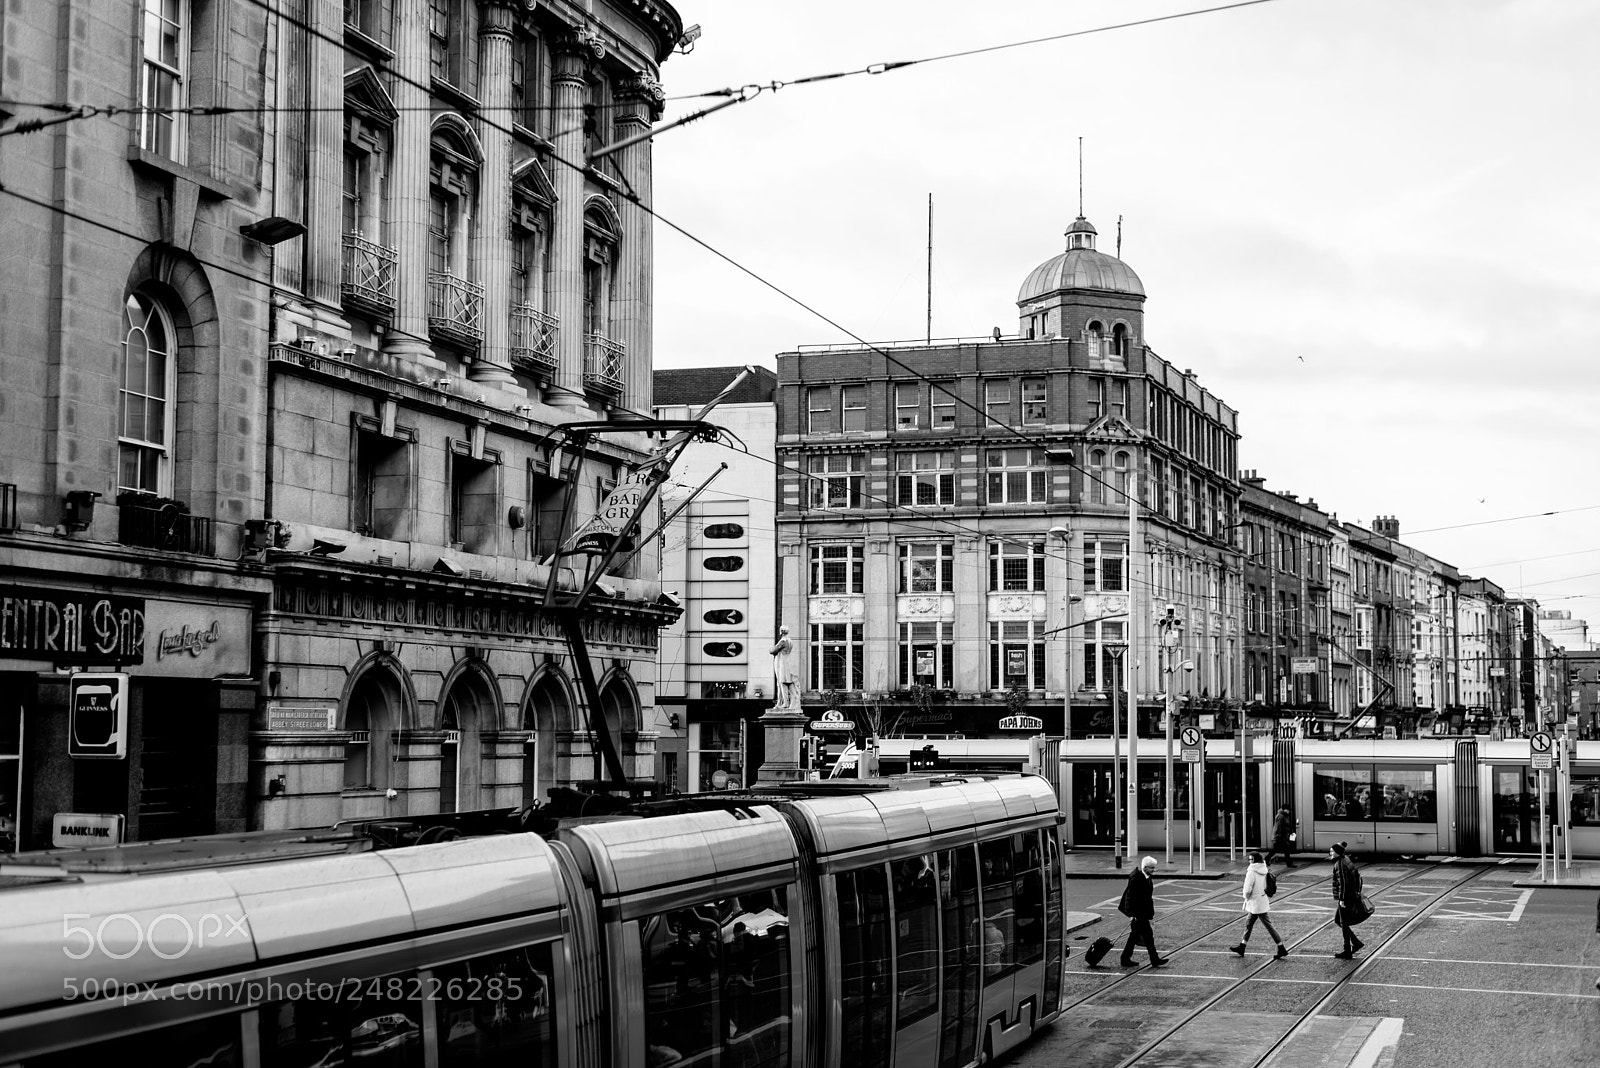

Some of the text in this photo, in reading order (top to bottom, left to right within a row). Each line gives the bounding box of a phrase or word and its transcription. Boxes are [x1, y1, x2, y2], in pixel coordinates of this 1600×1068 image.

[0, 597, 87, 652] ENTRAL
[271, 720, 288, 728] ABBEY
[1000, 718, 1018, 729] PAPA
[60, 826, 110, 838] BANKLINK
